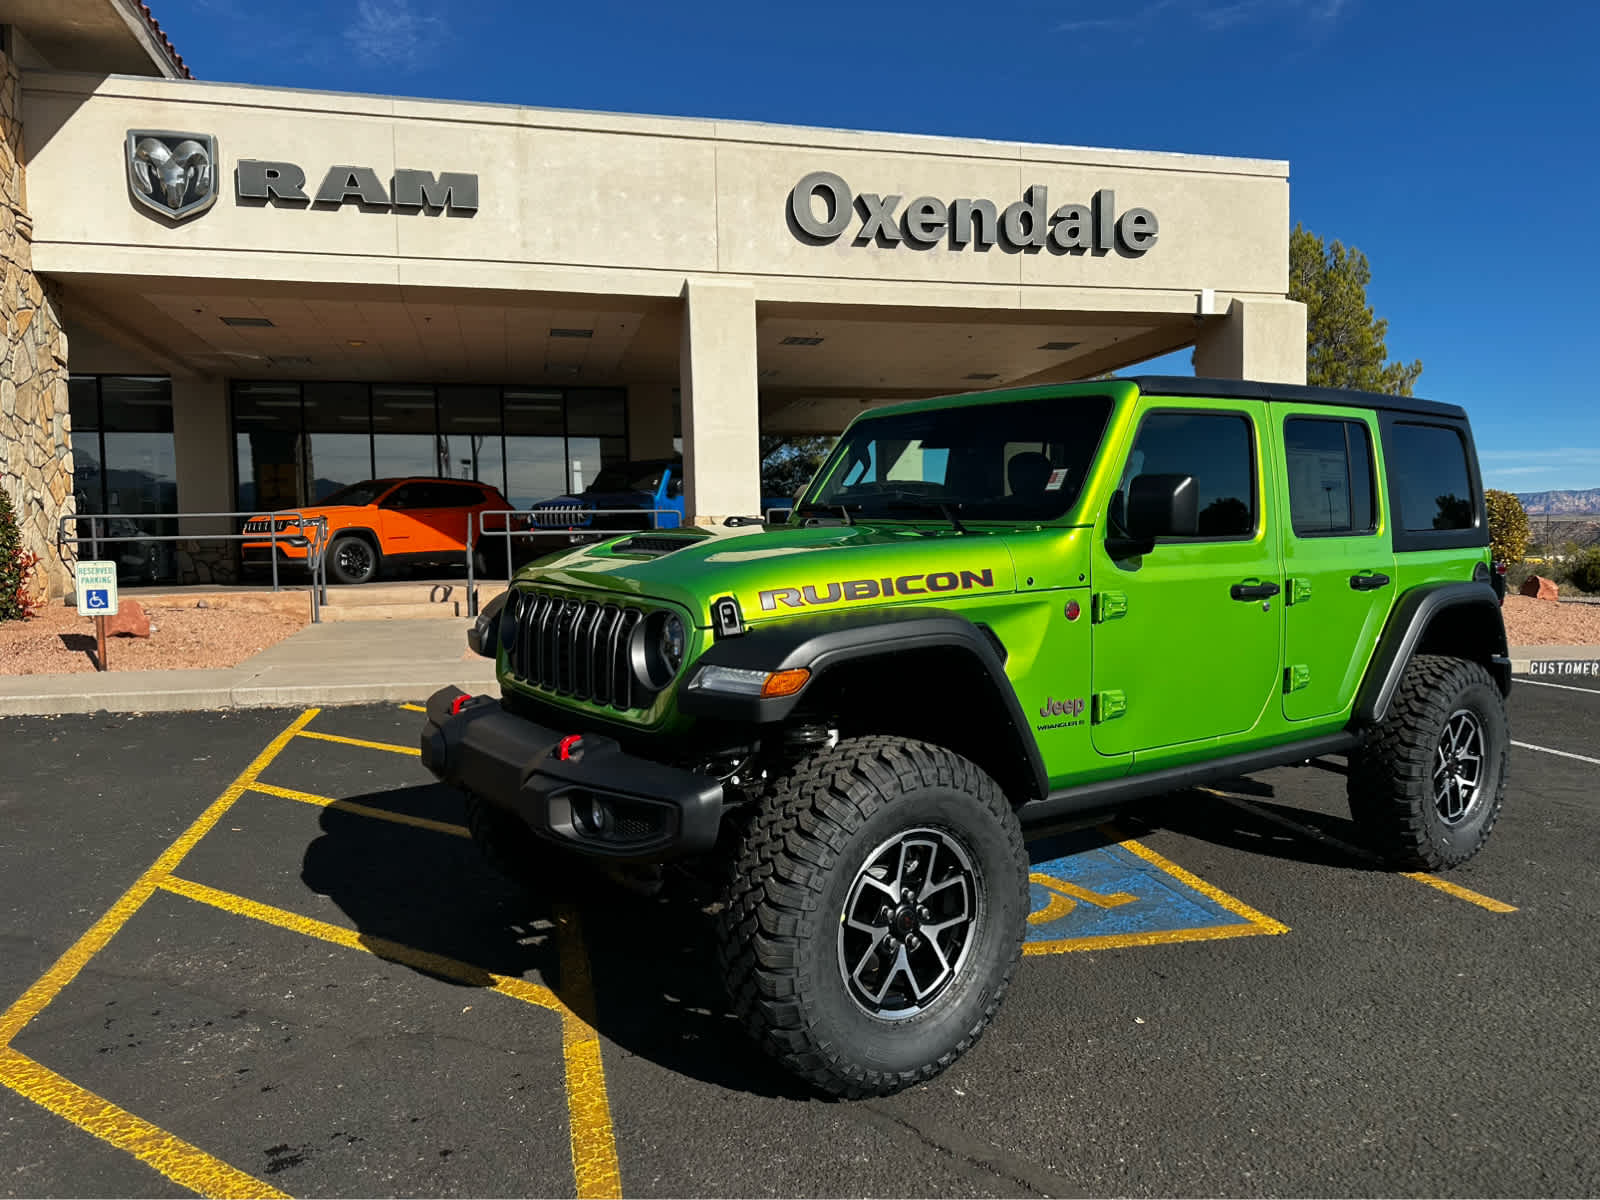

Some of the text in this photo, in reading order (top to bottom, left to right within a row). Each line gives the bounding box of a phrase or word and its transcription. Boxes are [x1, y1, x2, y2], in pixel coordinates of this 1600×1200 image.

[234, 159, 479, 218] RAM
[786, 171, 1159, 258] Oxendale
[758, 568, 994, 611] RUBICON
[1530, 662, 1599, 675] CUSTOMER
[1040, 696, 1085, 717] Jeep
